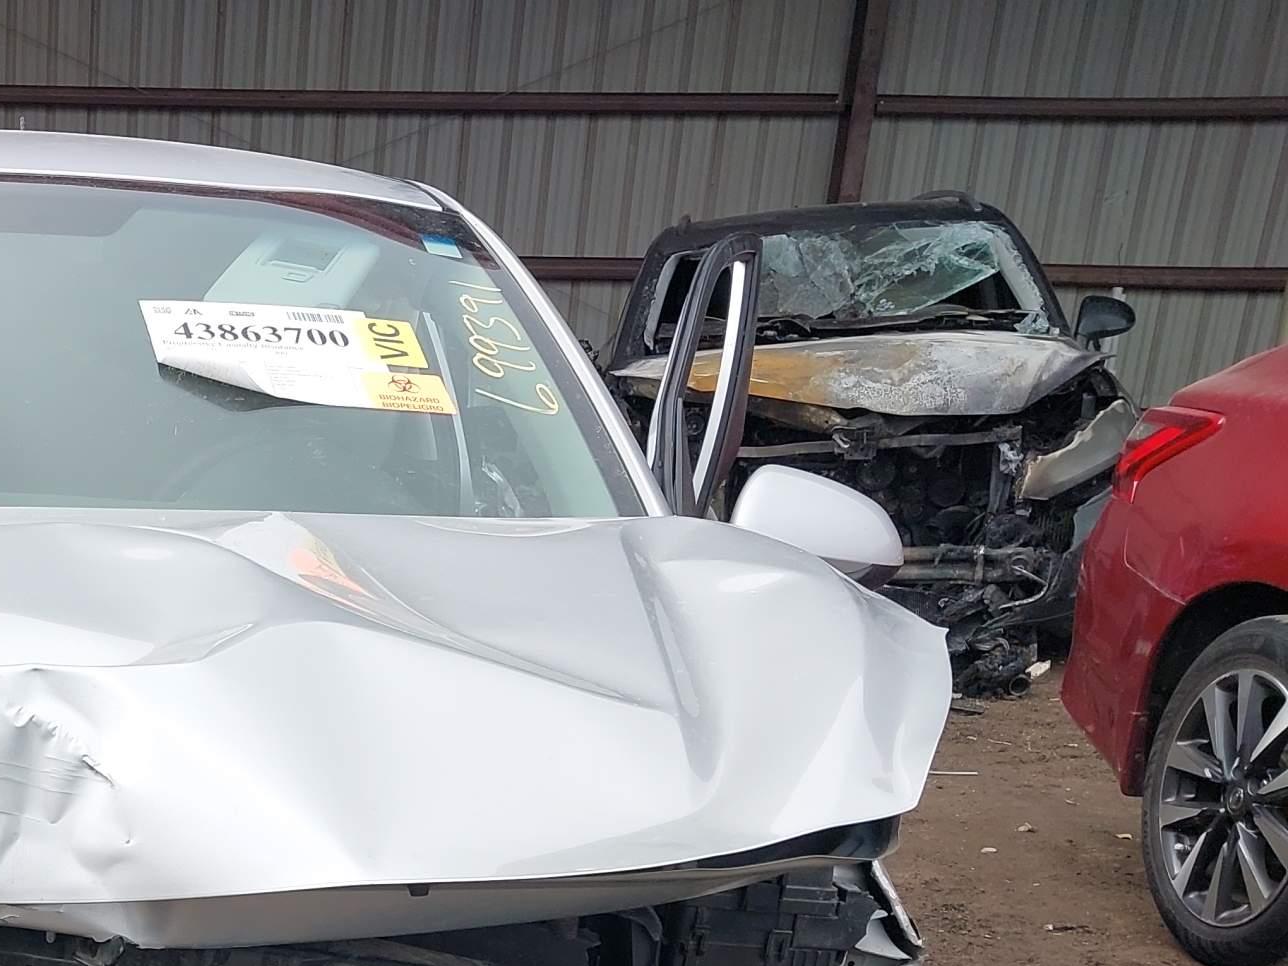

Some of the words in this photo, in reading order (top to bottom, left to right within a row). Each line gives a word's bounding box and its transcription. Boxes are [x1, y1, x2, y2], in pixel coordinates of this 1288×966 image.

[174, 322, 350, 348] 43863700
[367, 322, 409, 360] VIC
[378, 393, 440, 404] BIOHAZARD
